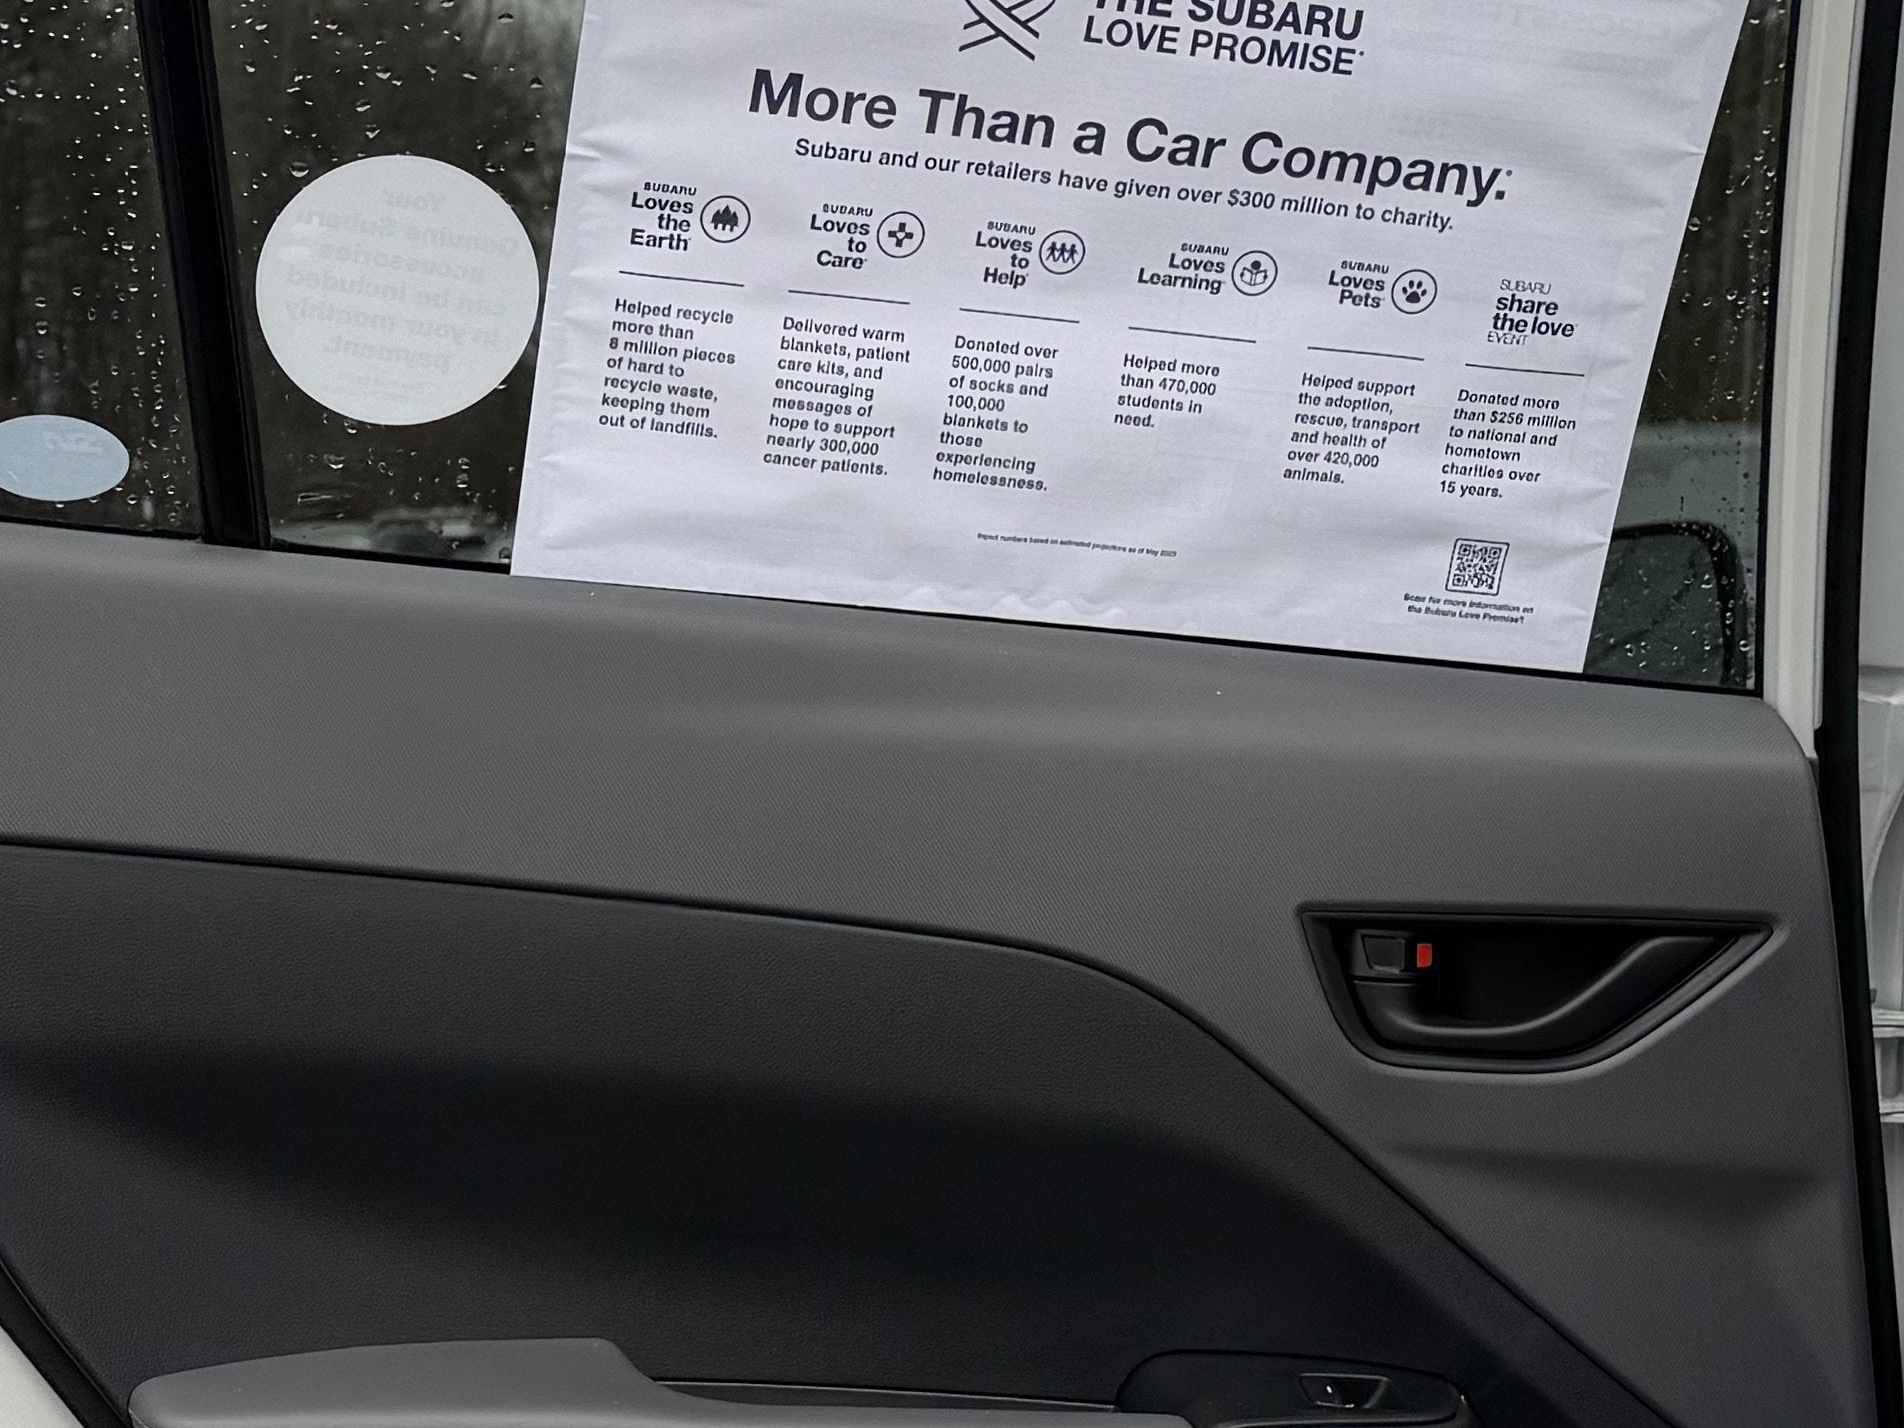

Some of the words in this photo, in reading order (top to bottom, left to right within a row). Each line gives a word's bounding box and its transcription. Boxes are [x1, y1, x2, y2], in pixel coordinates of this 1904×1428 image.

[1083, 15, 1180, 54] LOVE
[1189, 29, 1364, 75] PROMISE
[749, 68, 896, 129] More
[918, 88, 1054, 148] Than
[1073, 121, 1105, 155] a
[1126, 117, 1226, 168] Car
[1242, 131, 1512, 207] Company.
[644, 181, 696, 196] SUBARU
[795, 138, 871, 162] Subaru
[878, 151, 918, 168] and
[924, 157, 960, 172] our
[966, 160, 1051, 184] retailers
[1058, 169, 1107, 191] have
[1113, 178, 1170, 199] given
[1177, 188, 1222, 203] over
[1227, 188, 1275, 209] $300
[1280, 195, 1348, 217] million
[1355, 203, 1374, 220] to
[1381, 206, 1452, 233] charity.
[631, 192, 693, 214] Loves
[823, 203, 873, 217] SUBARU
[658, 212, 691, 232] the
[810, 214, 870, 235] Loves
[987, 221, 1036, 235] SUBARU
[630, 228, 689, 251] Earth
[848, 237, 866, 252] to
[975, 231, 1032, 252] Loves
[1181, 242, 1229, 256] SUBARU
[816, 250, 864, 269] Care
[1010, 254, 1029, 269] to
[1168, 253, 1225, 273] Loves
[1340, 261, 1389, 274] SUBARU
[983, 267, 1027, 289] Help
[1137, 268, 1222, 294] Learning
[1328, 270, 1385, 291] Loves
[1500, 279, 1551, 295] SUBARU
[1338, 289, 1382, 308] Pets
[1496, 294, 1558, 316] share
[614, 297, 671, 318] Helped
[676, 308, 733, 324] recycle
[612, 320, 653, 335] more
[659, 324, 693, 339] than
[783, 316, 857, 337] Delivered
[862, 328, 904, 342] warm
[1492, 313, 1528, 333] the
[1531, 316, 1575, 338] love
[780, 335, 850, 359] blankets,
[855, 347, 910, 363] patient
[954, 335, 1019, 354] Donated
[1024, 346, 1058, 358] over
[1487, 331, 1528, 346] EVENT
[609, 337, 618, 349] 8
[623, 339, 677, 357] million
[682, 347, 735, 364] pieces
[606, 356, 623, 369] of
[627, 357, 664, 374] hard
[669, 364, 684, 377] to
[777, 358, 811, 372] care
[816, 360, 848, 378] kits,
[853, 366, 882, 379] and
[952, 355, 1010, 373] 500,000
[1014, 363, 1052, 378] pairs
[1123, 353, 1177, 372] Helped
[1181, 362, 1219, 376] more
[604, 376, 661, 393] recycle
[667, 384, 717, 402] waste,
[775, 378, 874, 401] encouraging
[949, 375, 964, 388] of
[969, 379, 1014, 393] socks
[1019, 384, 1048, 397] and
[1120, 373, 1153, 389] than
[1158, 377, 1216, 395] 470,000
[1301, 372, 1353, 391] Helped
[1357, 380, 1415, 396] support
[601, 392, 664, 415] keeping
[670, 402, 709, 418] them
[772, 397, 851, 416] messages
[856, 404, 873, 417] of
[947, 394, 1005, 412] 100,000
[1117, 394, 1183, 411] students
[1188, 399, 1202, 413] in
[1298, 392, 1321, 406] the
[1324, 395, 1392, 415] adoption,
[1457, 389, 1519, 406] Donated
[1522, 397, 1559, 409] more
[599, 414, 625, 427] out
[629, 416, 646, 429] of
[650, 417, 717, 438] landfills.
[769, 413, 808, 431] hope
[814, 418, 829, 432] to
[833, 423, 895, 438] support
[943, 412, 1008, 431] blankets
[1013, 420, 1028, 433] to
[1114, 414, 1154, 427] need.
[1294, 413, 1347, 429] rescue,
[1352, 416, 1419, 434] transport
[1453, 407, 1485, 422] than
[1489, 410, 1523, 425] $256
[1527, 415, 1576, 430] million
[766, 434, 815, 452] nearly
[819, 438, 878, 455] 300,000
[940, 431, 982, 447] those
[1291, 431, 1319, 443] and
[1322, 431, 1366, 447] health
[1371, 436, 1386, 449] of
[1449, 425, 1463, 437] to
[1467, 428, 1526, 443] national
[1529, 434, 1558, 446] and
[1287, 450, 1320, 462] over
[1323, 451, 1379, 467] 420,000
[1445, 442, 1520, 461] hometown
[763, 453, 817, 468] cancer
[820, 458, 887, 475] patients.
[936, 451, 1035, 474] experiencing
[1441, 462, 1503, 478] charities
[1508, 470, 1540, 482] over
[933, 466, 1047, 491] homelessness.
[1283, 467, 1344, 483] animals.
[1440, 480, 1455, 493] 15
[1459, 484, 1502, 497] years.
